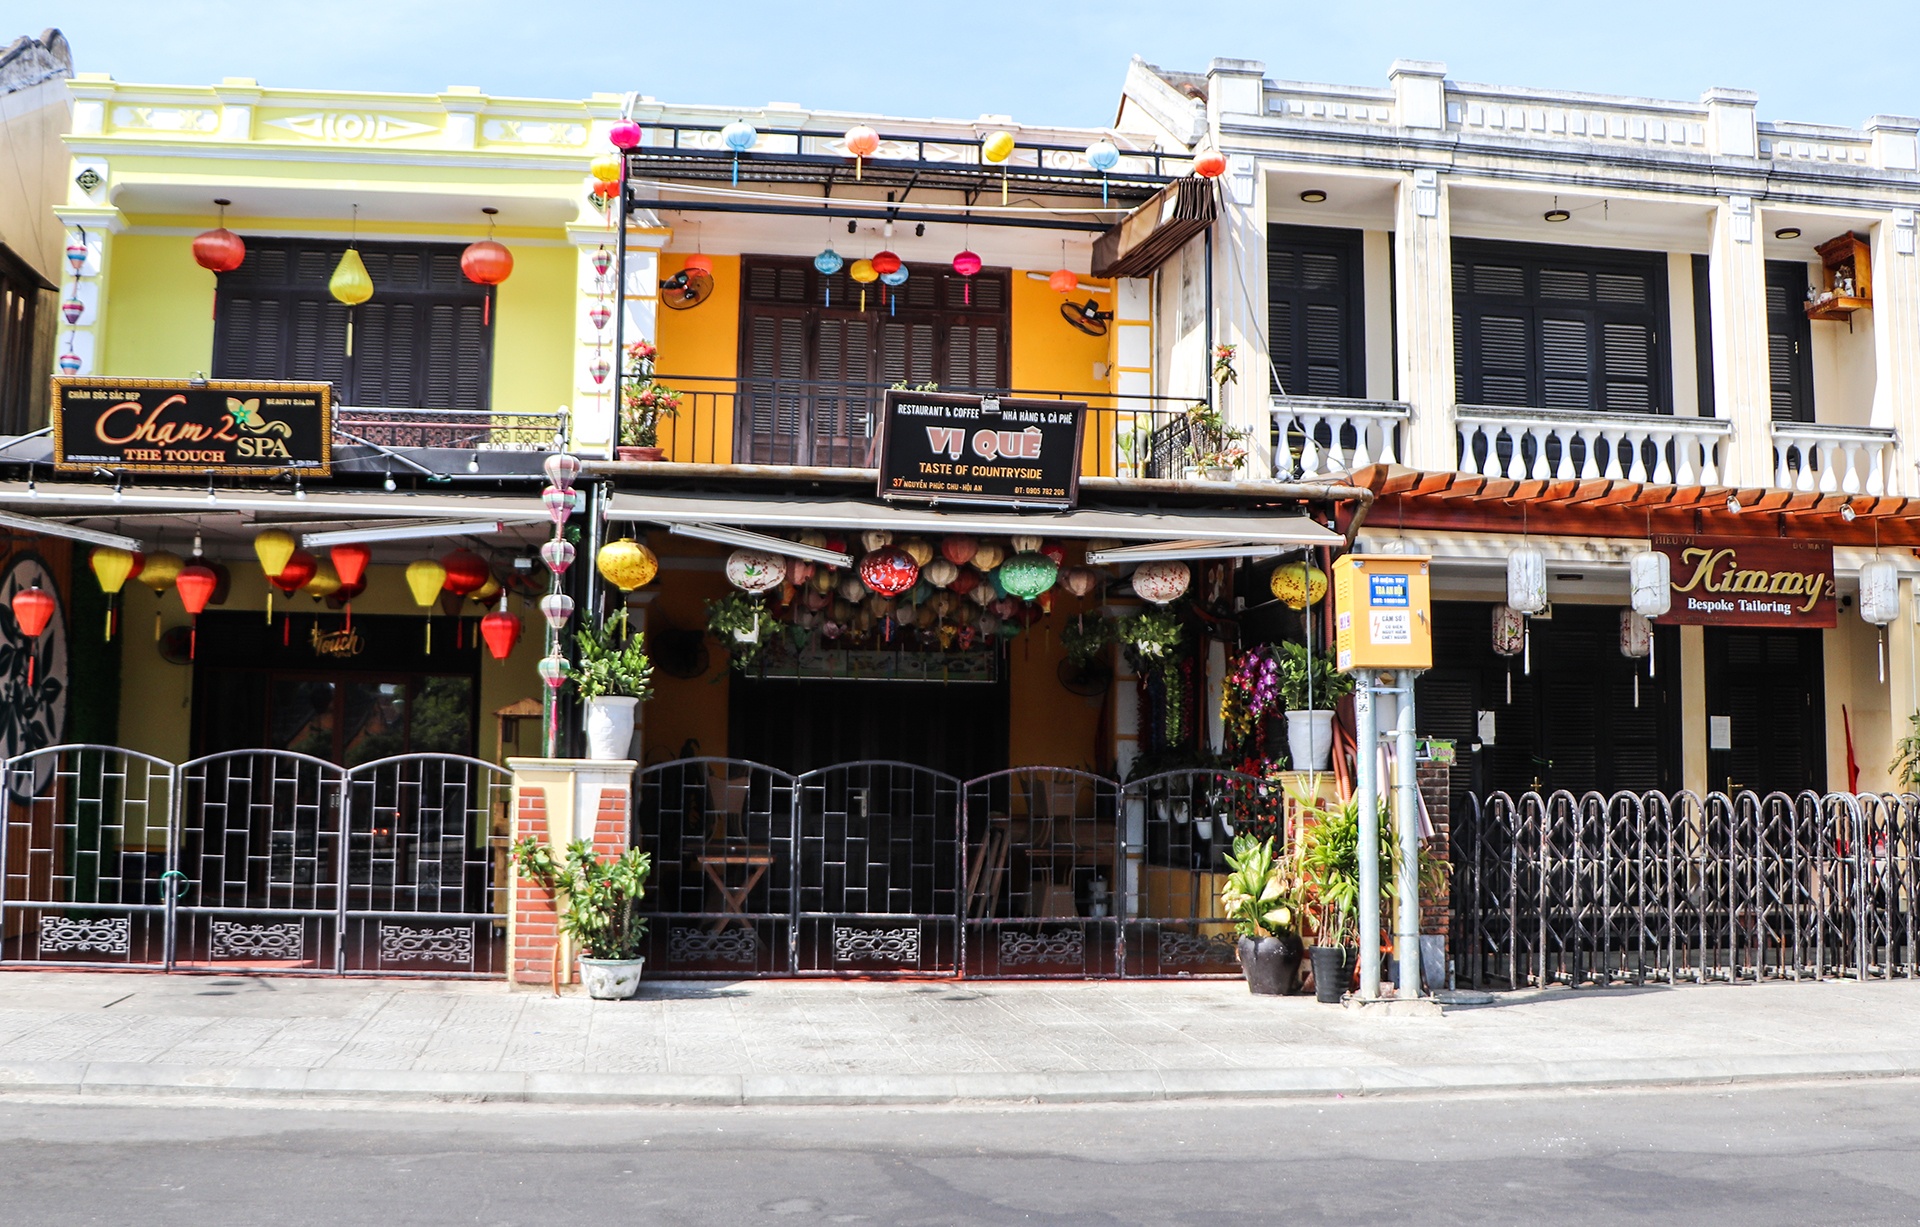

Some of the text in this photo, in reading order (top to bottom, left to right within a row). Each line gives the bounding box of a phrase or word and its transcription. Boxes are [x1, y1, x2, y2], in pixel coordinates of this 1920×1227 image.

[266, 398, 292, 406] BEAUTY
[897, 403, 980, 419] RESTAURANT & COFFEE
[1002, 408, 1073, 424] NHÀ HÀNG & CÀ PHÊ
[95, 394, 239, 447] Chạm 2
[237, 437, 293, 458] SPA
[925, 425, 1043, 462] VỊ QUÊ
[123, 448, 162, 461] THE
[164, 449, 226, 463] TOUCH
[919, 462, 1043, 480] TASTE OF COUNTRYSIDE
[892, 477, 903, 488] 37
[973, 484, 983, 493] AN
[1026, 487, 1041, 495] 0905
[1670, 547, 1836, 613] Kimmy 2
[1687, 597, 1791, 615] Bespoke Tailoring
